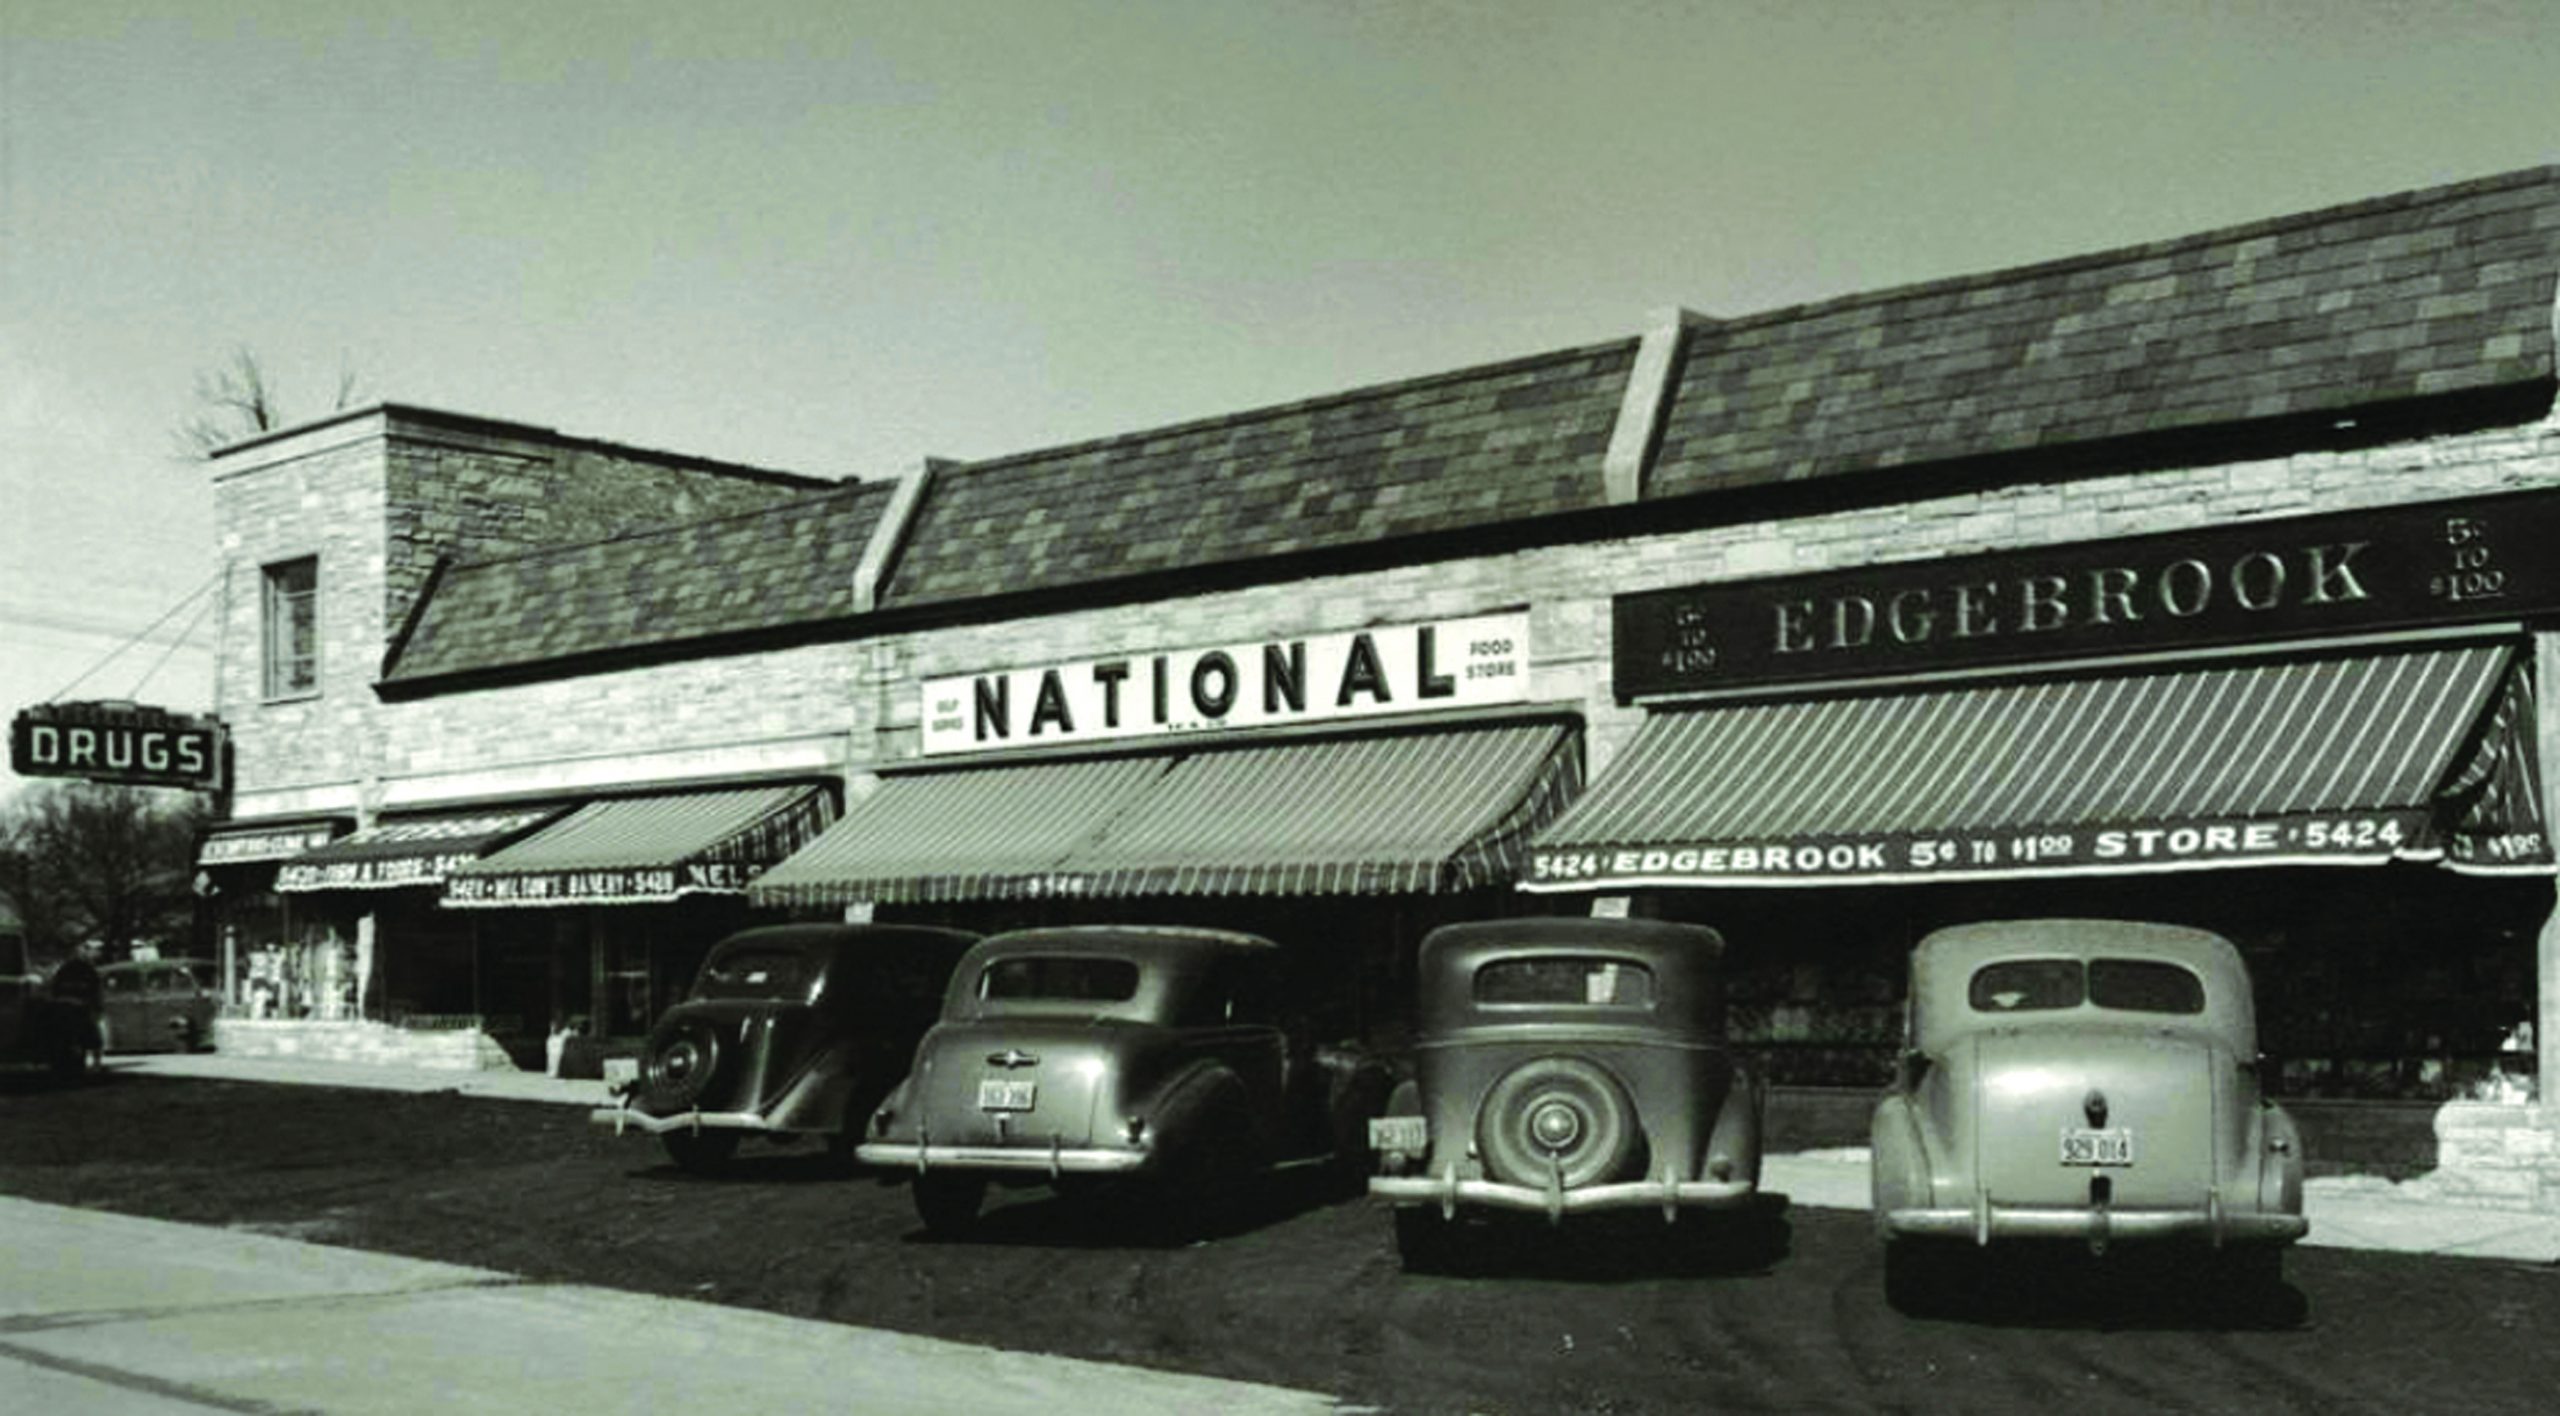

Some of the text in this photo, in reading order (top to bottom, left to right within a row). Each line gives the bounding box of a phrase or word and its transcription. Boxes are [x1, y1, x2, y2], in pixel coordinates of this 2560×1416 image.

[1774, 540, 2371, 653] EDGEBROOK
[975, 627, 1455, 742] NATIONAL
[1465, 661, 1516, 680] STORE
[31, 726, 203, 772] DRUGS
[1534, 853, 1598, 880] 5424
[1612, 842, 1885, 872] EDGEBROOK
[1971, 840, 1997, 863] TO
[2094, 824, 2280, 858] STORE
[2306, 819, 2402, 848] 5424
[2064, 1138, 2127, 1160] 929 014
